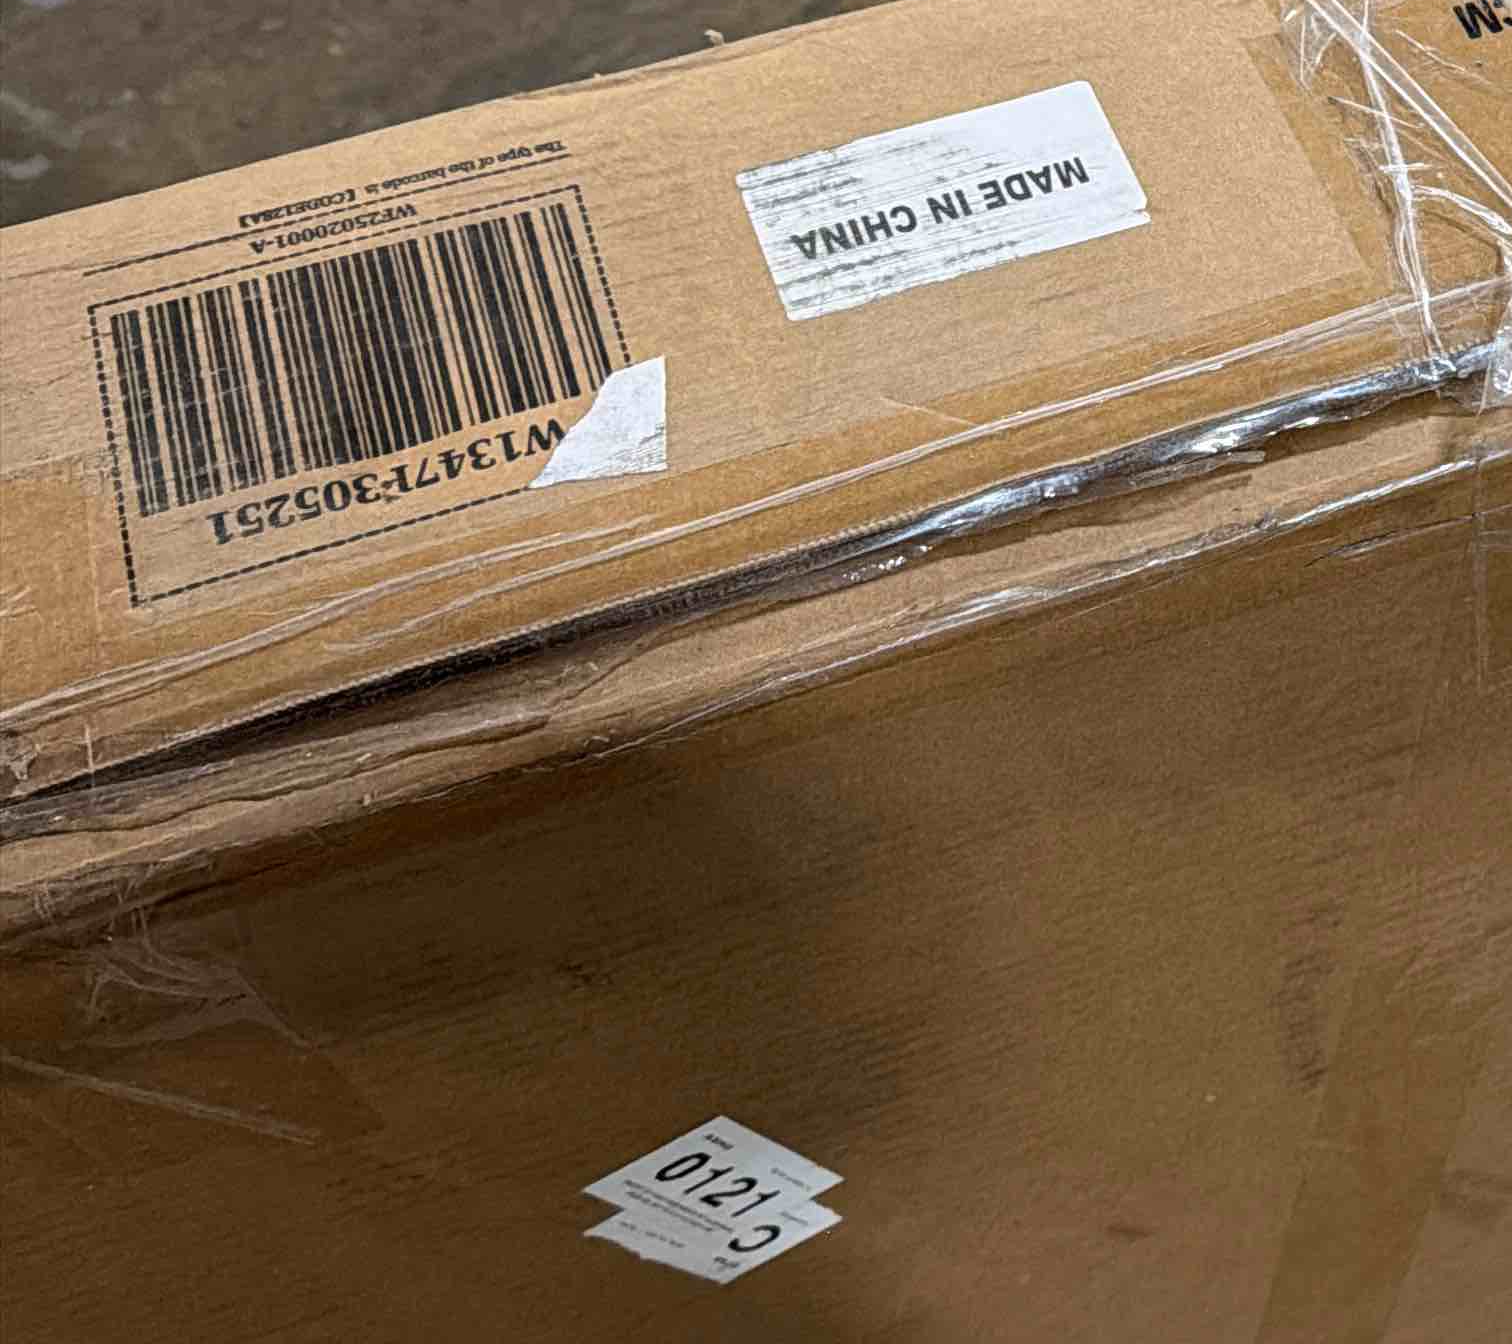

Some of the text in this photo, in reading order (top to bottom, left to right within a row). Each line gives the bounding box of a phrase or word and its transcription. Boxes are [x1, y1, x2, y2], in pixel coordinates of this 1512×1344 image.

[533, 139, 567, 155] The
[476, 155, 496, 170] of
[498, 147, 533, 165] type
[448, 159, 476, 174] the
[381, 166, 447, 191] barcode
[364, 183, 380, 196] is
[789, 156, 1091, 261] MADE IN CHINA
[249, 203, 418, 255] WF25020001-A
